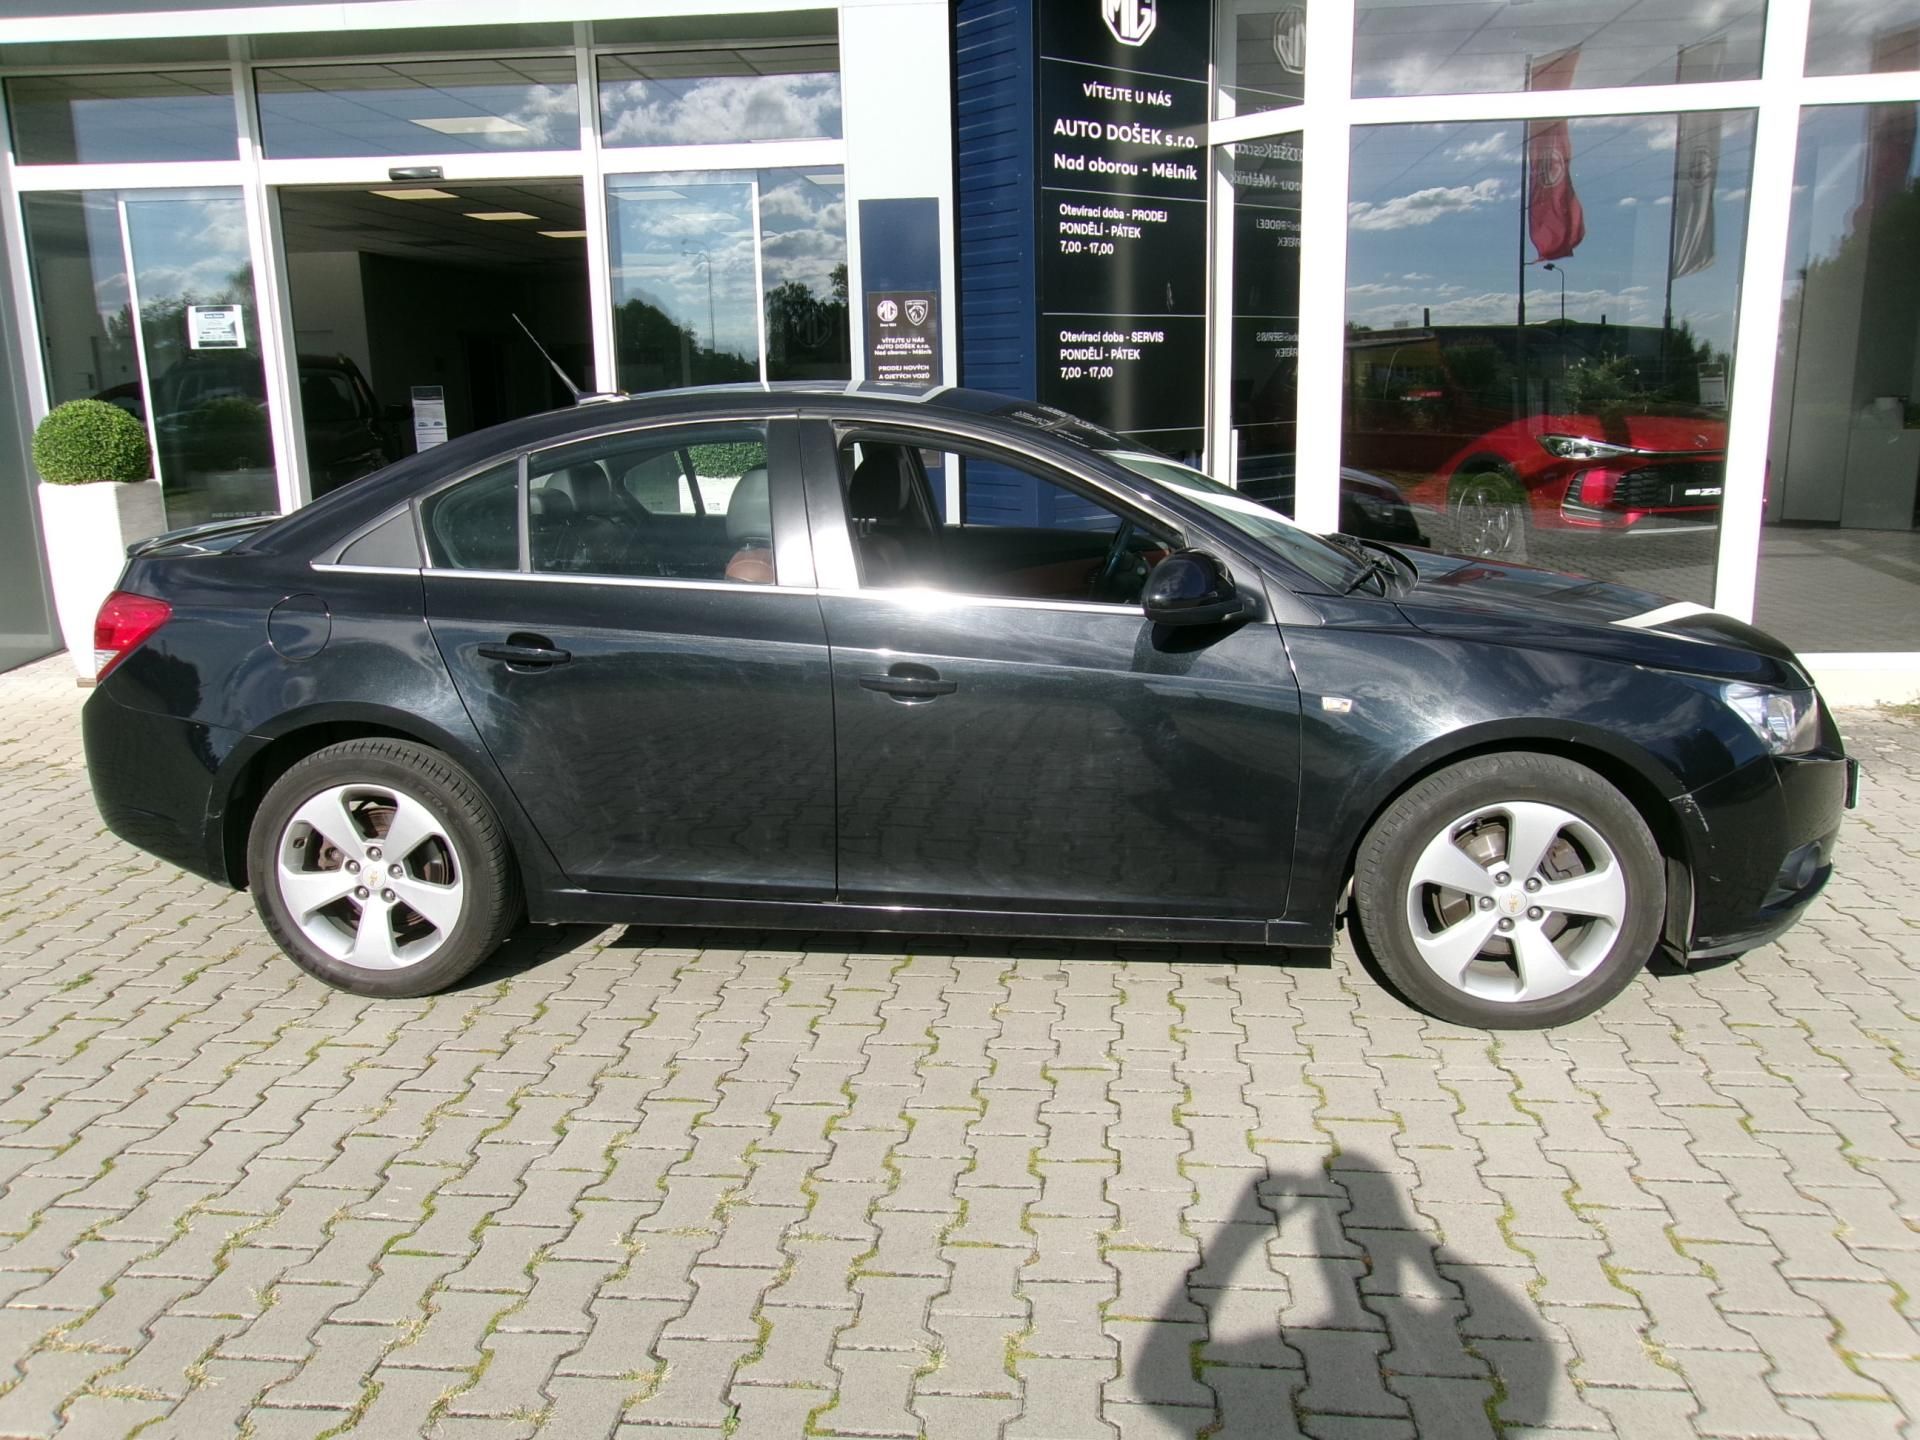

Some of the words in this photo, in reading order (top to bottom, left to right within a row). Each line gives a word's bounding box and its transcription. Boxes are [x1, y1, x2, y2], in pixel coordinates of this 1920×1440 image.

[1103, 0, 1155, 43] MG
[1083, 81, 1133, 103] VÍTEJTE
[1135, 91, 1145, 104] U
[1147, 90, 1172, 107] NÁS
[1053, 118, 1102, 139] AUTO
[1106, 123, 1162, 145] DOŠEK
[1165, 134, 1199, 149] s.r.o.
[1053, 153, 1085, 172] Nad
[1088, 156, 1139, 176] oborou
[1151, 162, 1198, 181] Mělník
[1059, 203, 1101, 218] Otevírací
[1102, 206, 1125, 220] doba
[1132, 209, 1168, 222] PRODEJ
[1059, 221, 1104, 236] PONDĚLÍ
[1111, 224, 1142, 239] PÁTEK
[1060, 240, 1082, 255] 7,00
[1089, 241, 1114, 256] 17,00
[878, 300, 898, 321] MG
[1059, 330, 1101, 344] Otevírací
[1102, 330, 1125, 344] doba
[1131, 331, 1165, 344] SERVIS
[1059, 346, 1104, 361] PONDĚLÍ
[1110, 346, 1141, 361] PÁTEK
[1060, 366, 1082, 379] 7,00
[1089, 366, 1114, 380] 17,00
